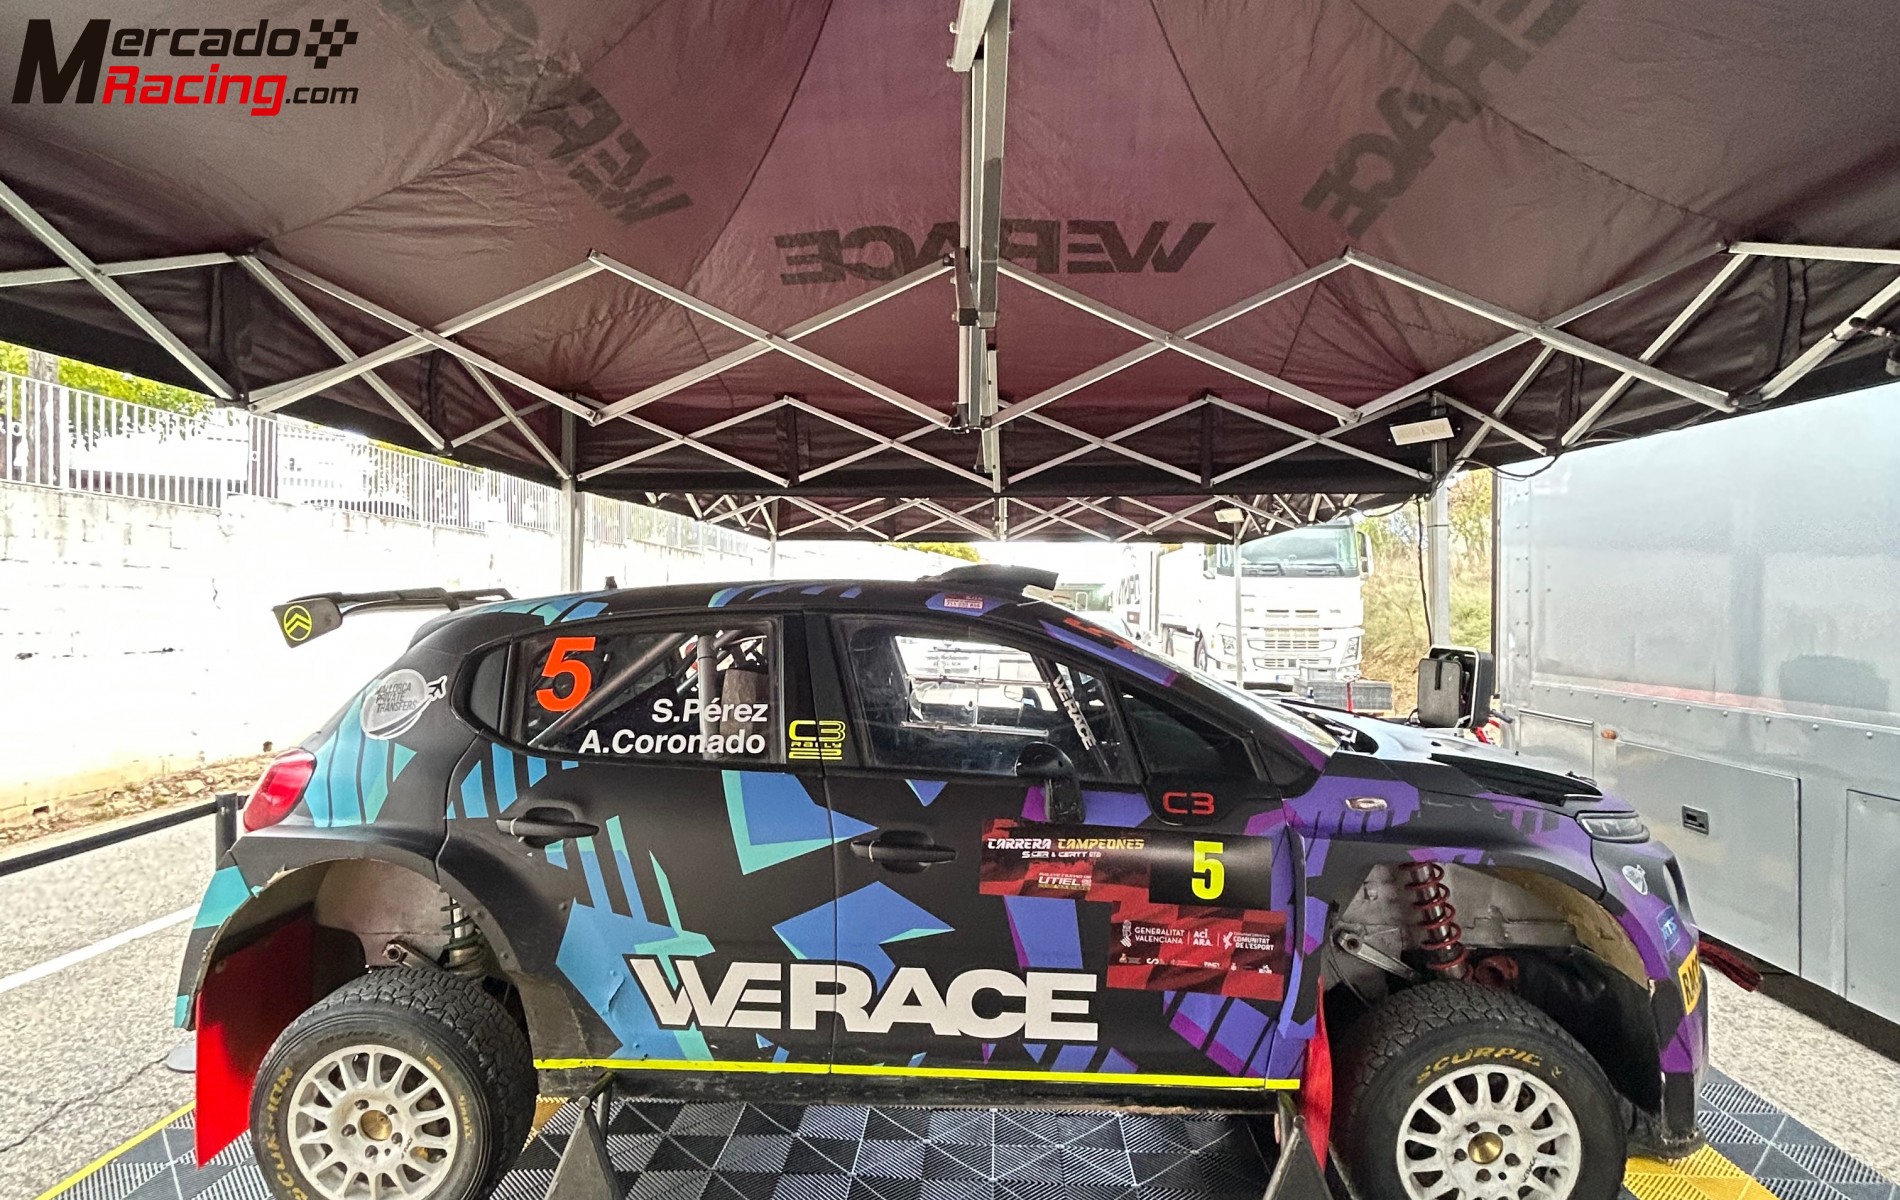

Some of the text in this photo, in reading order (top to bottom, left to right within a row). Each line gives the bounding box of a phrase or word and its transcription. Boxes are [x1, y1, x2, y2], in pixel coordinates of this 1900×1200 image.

[535, 637, 596, 712] 5
[376, 691, 405, 704] PRIVATE
[376, 700, 418, 713] TRANSFERS
[651, 697, 768, 723] S.Pérez
[1052, 675, 1096, 750] WERACE
[789, 720, 846, 741] C3
[578, 729, 766, 754] A.Coronado
[1162, 792, 1215, 815] C3
[987, 838, 1145, 850] CARRERA CAMPEONES
[1191, 840, 1225, 900] 5
[1038, 876, 1081, 887] UTIEL
[1135, 927, 1185, 937] GENERALITAT
[1135, 935, 1183, 945] VALENCIANA
[1233, 936, 1270, 944] COMUNITAT
[628, 958, 1099, 1041] WERACE
